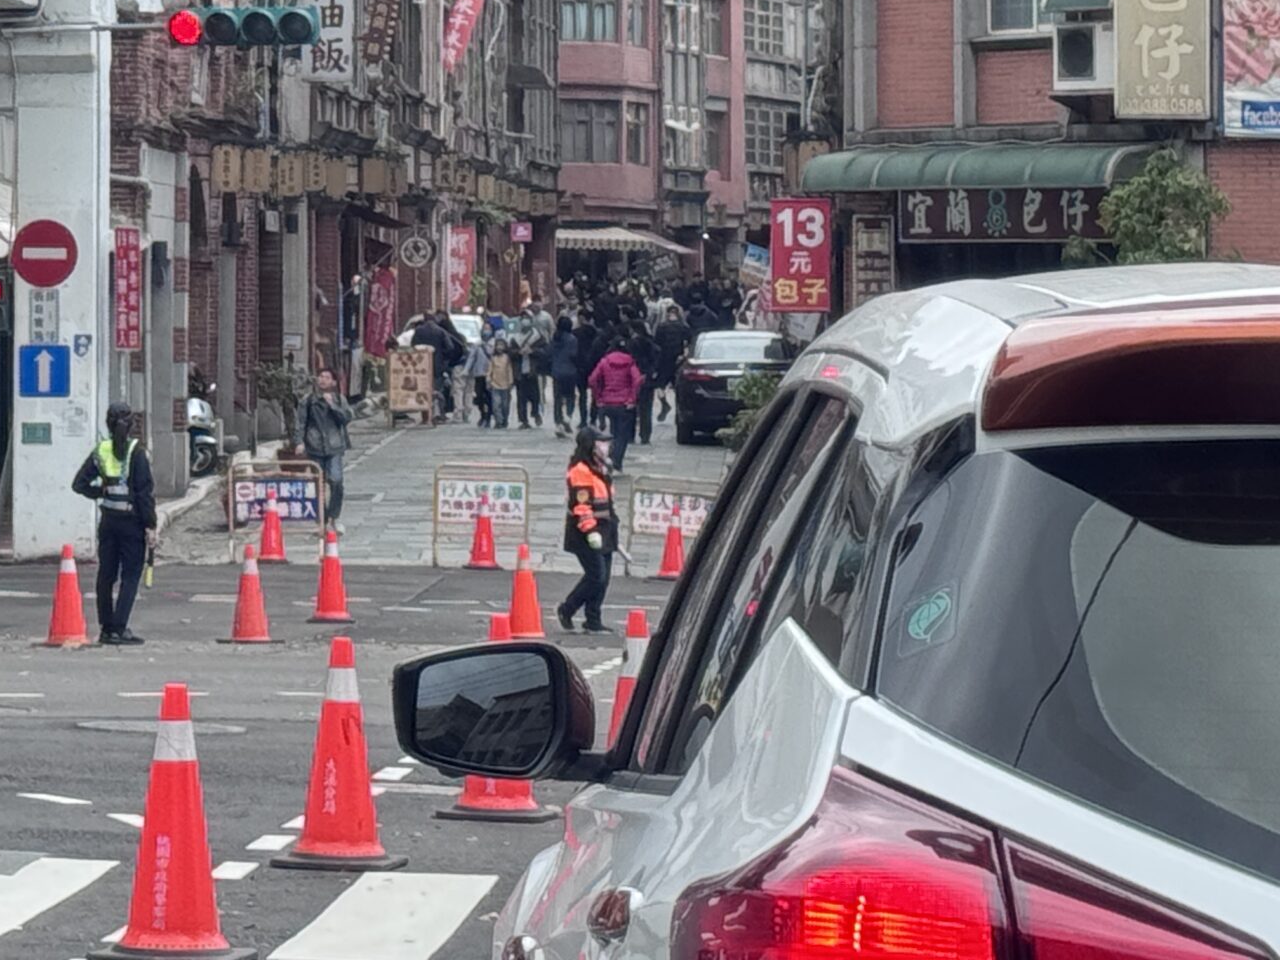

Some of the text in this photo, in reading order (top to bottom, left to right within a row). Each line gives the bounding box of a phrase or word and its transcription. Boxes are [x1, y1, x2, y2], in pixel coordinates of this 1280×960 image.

[1243, 104, 1280, 126] faceb
[776, 207, 826, 248] 13
[789, 251, 812, 275] 元
[774, 278, 827, 305] 包子
